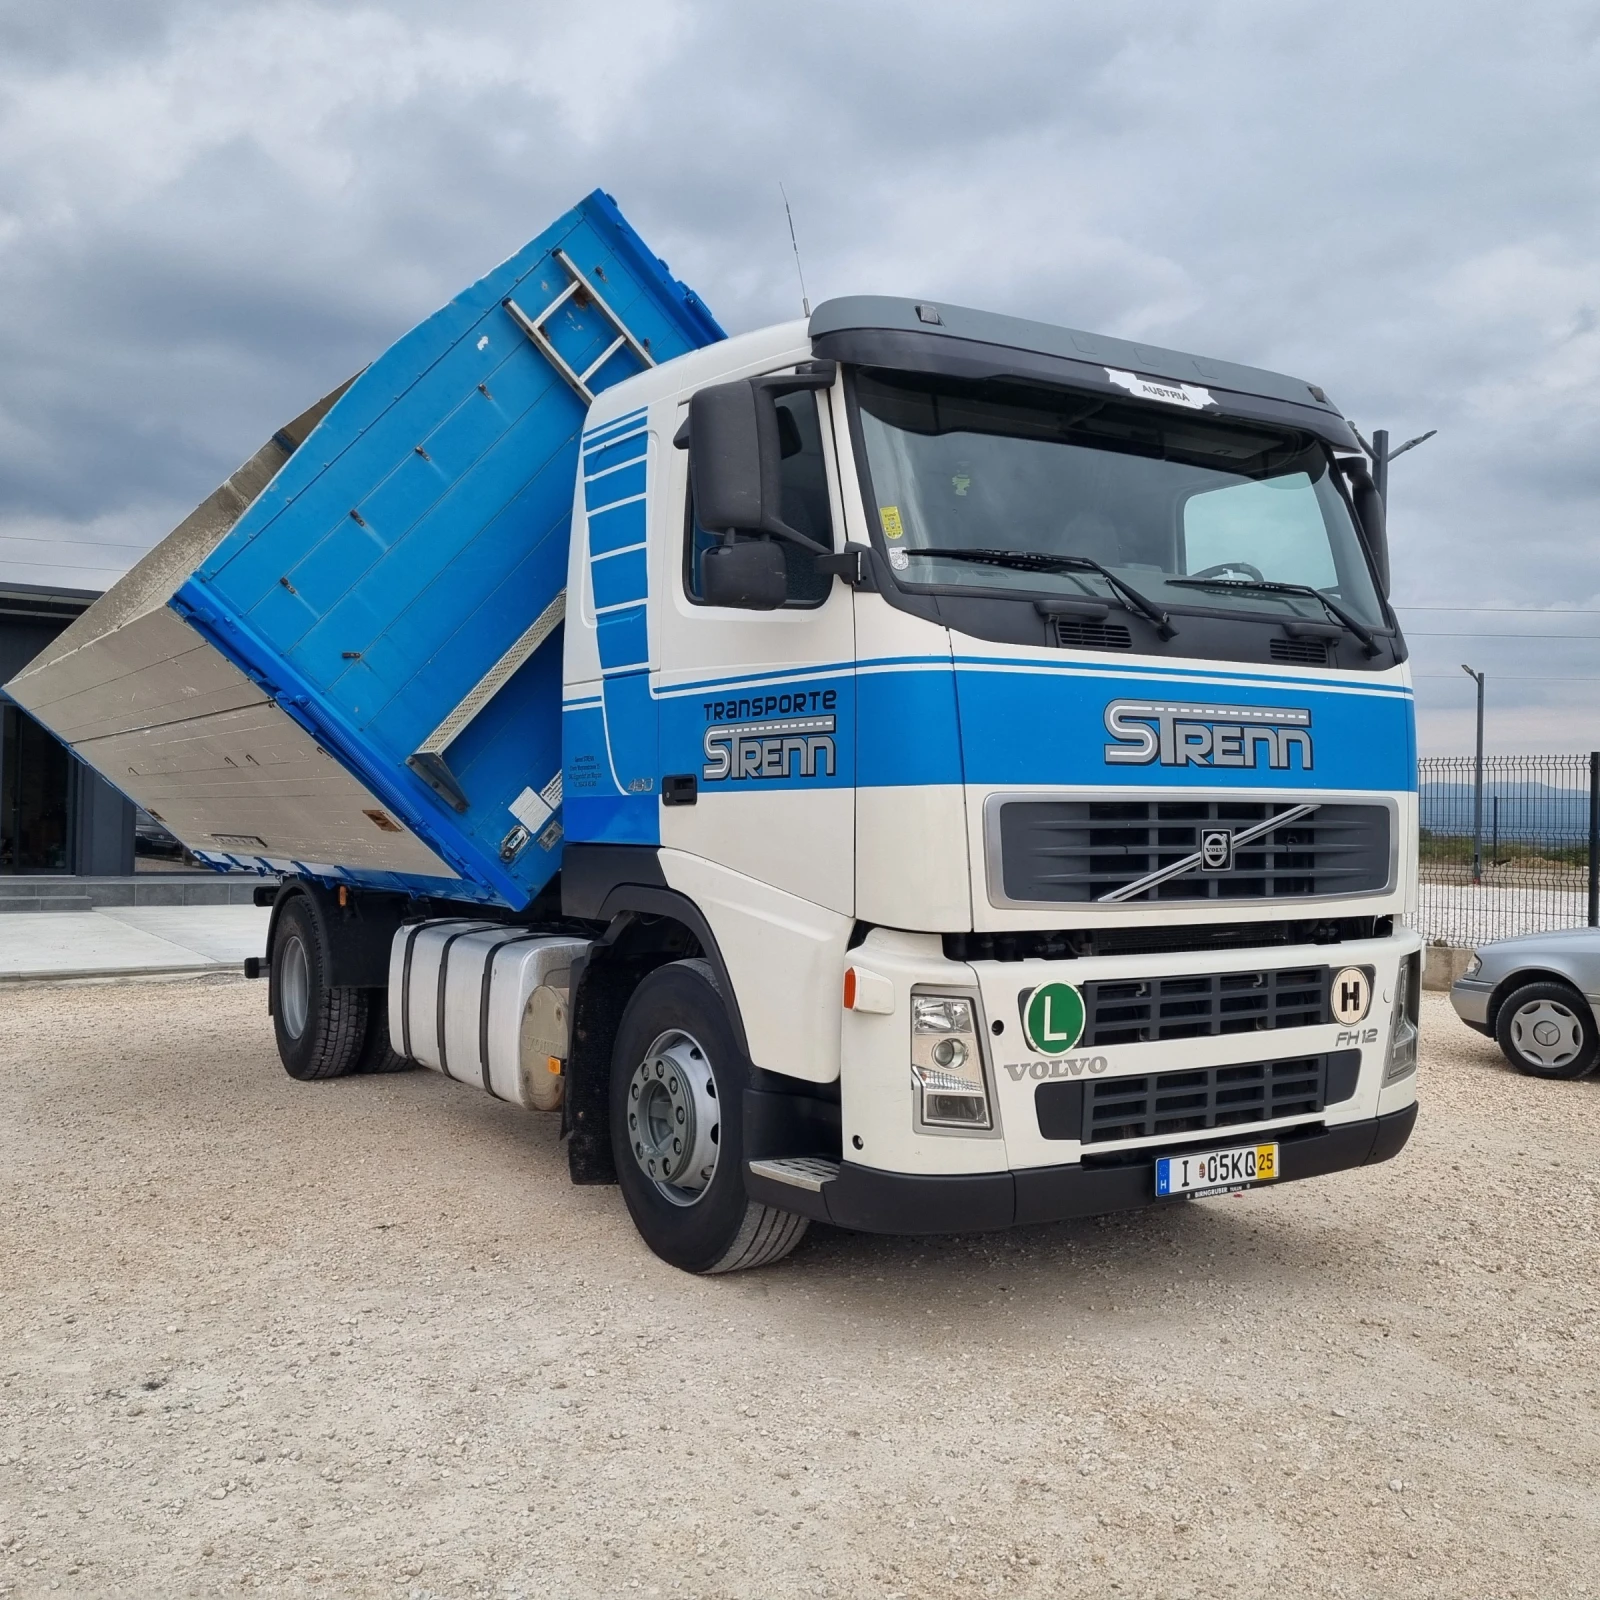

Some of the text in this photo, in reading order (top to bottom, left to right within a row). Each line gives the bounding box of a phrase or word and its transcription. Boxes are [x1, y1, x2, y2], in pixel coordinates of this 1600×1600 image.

[1142, 384, 1191, 402] AUSTRIA
[1341, 981, 1360, 1012] H
[1043, 995, 1067, 1041] L
[1004, 1056, 1108, 1081] VOLVO
[1160, 1179, 1167, 1190] H
[1258, 1153, 1273, 1170] 25
